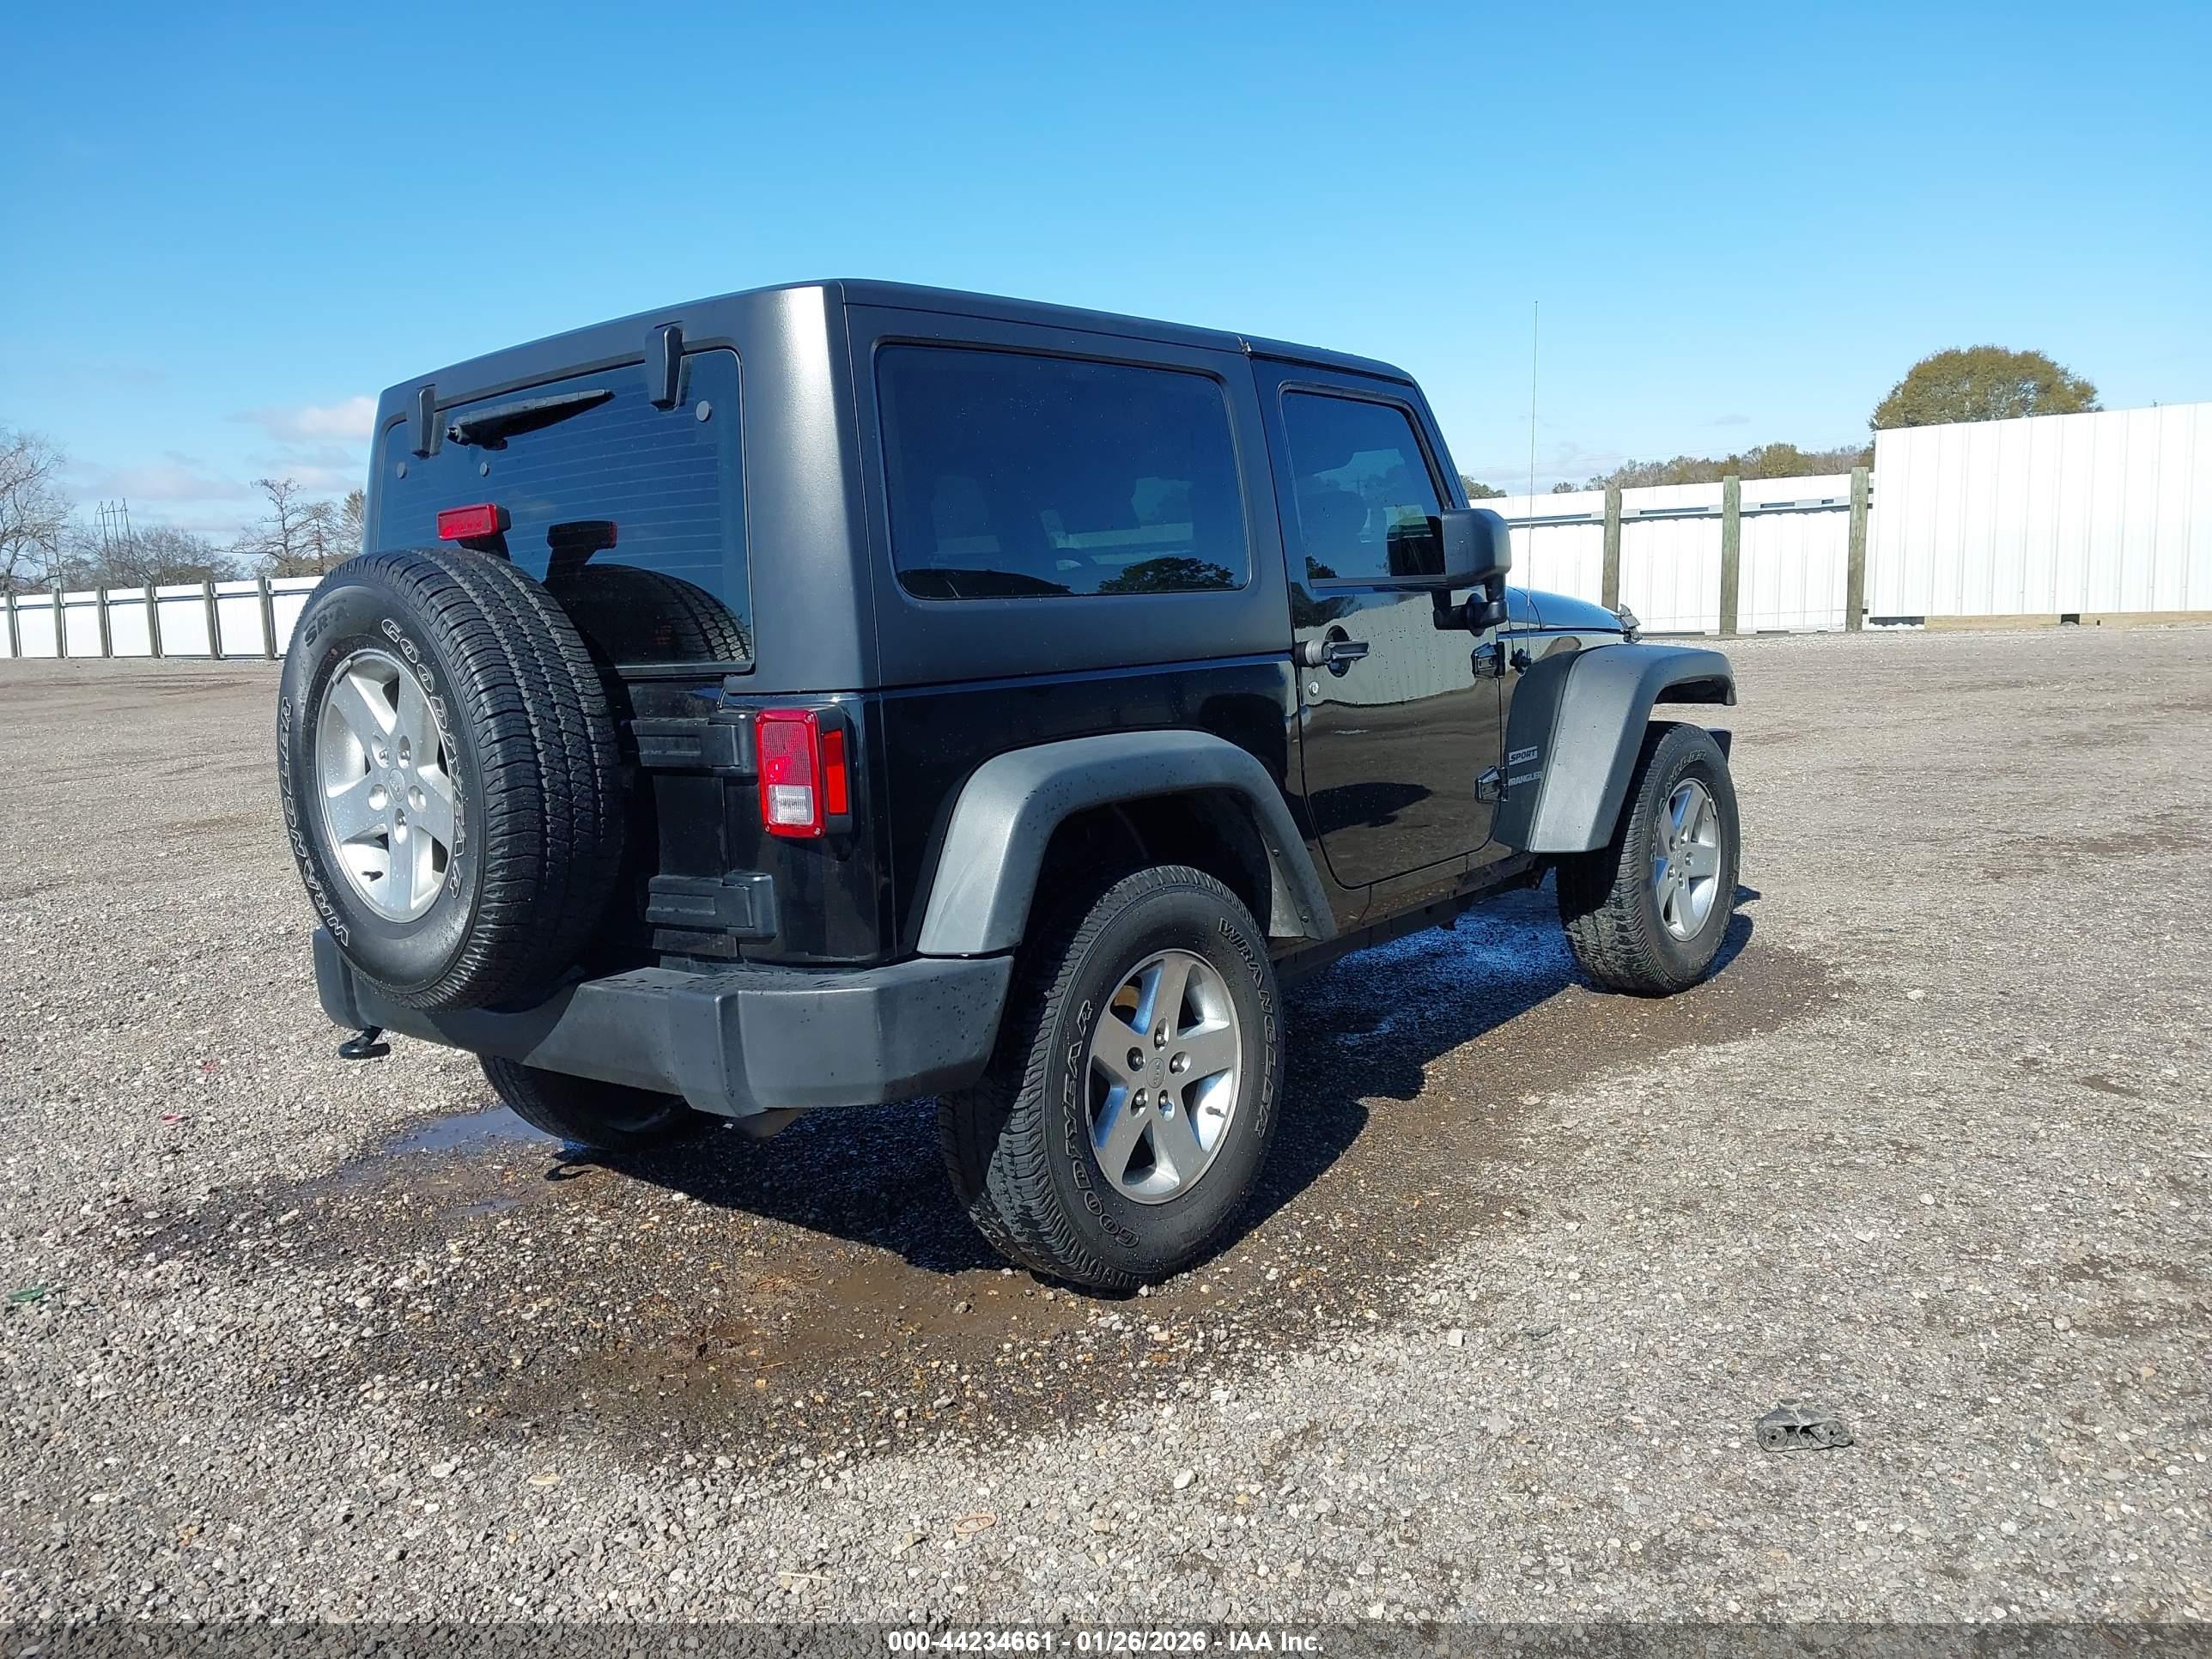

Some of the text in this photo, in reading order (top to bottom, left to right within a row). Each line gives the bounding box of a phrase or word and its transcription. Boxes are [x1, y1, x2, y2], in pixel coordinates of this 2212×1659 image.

[278, 696, 349, 949] WRANGLER
[381, 618, 467, 899] GOODYEAR
[1510, 748, 1536, 763] SPORT
[1061, 999, 1140, 1249] GOODYEAR
[1218, 916, 1276, 1138] WRANGLER
